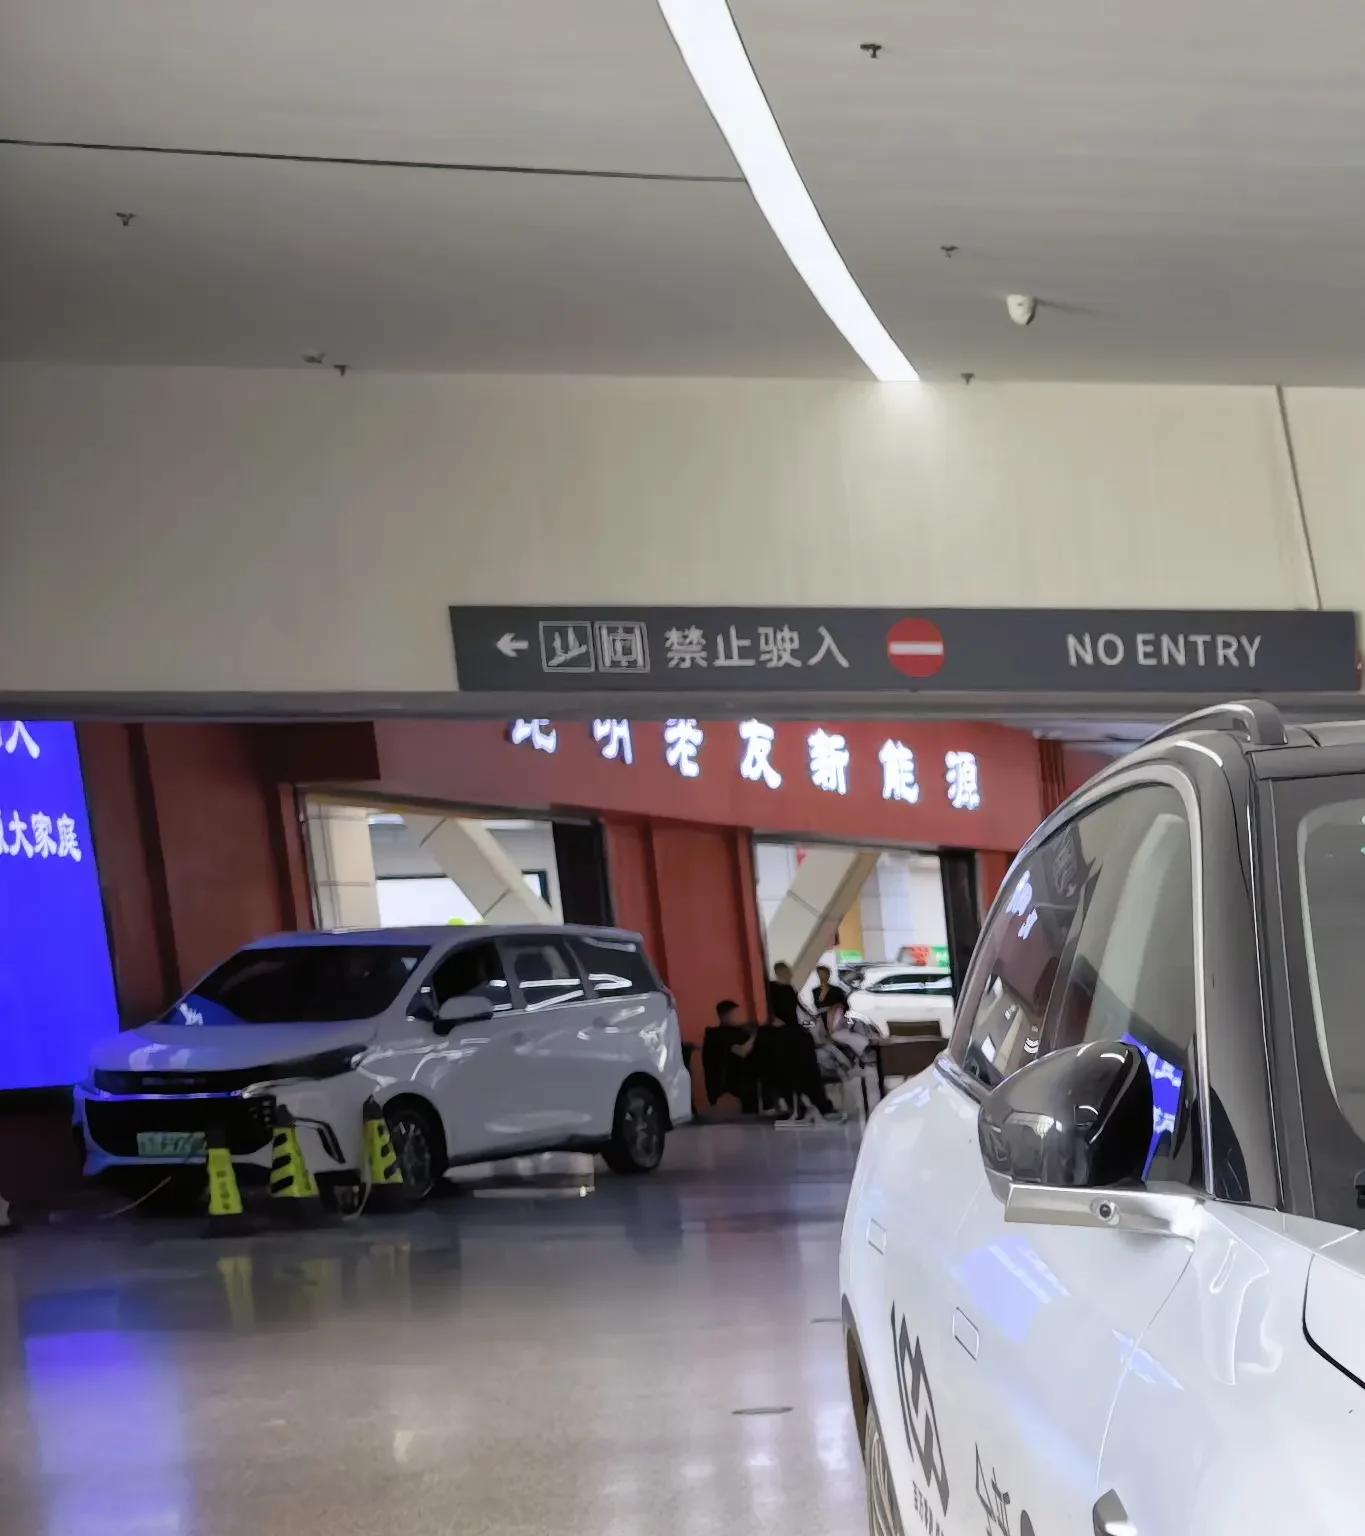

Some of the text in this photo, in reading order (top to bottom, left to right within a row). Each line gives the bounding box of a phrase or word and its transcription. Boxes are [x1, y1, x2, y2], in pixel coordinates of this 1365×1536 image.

[664, 624, 849, 668] 禁止驶入
[1066, 632, 1262, 668] NO ENTRY
